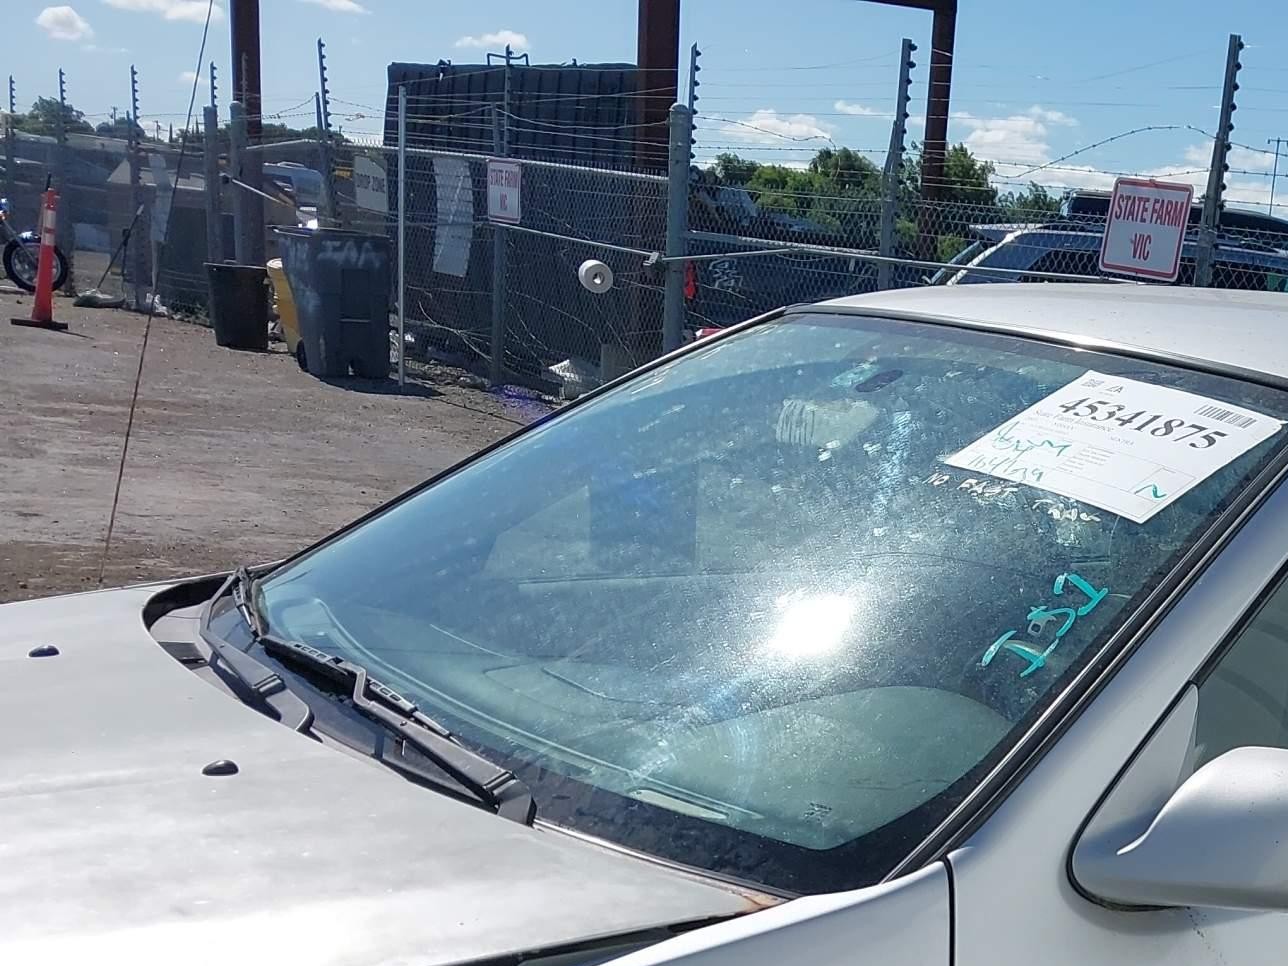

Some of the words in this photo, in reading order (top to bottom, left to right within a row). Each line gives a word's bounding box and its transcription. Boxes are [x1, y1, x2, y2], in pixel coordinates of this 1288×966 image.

[1114, 194, 1151, 224] STATE
[1149, 197, 1185, 228] FARM
[1132, 232, 1152, 261] VIC
[1059, 397, 1229, 448] 45341875
